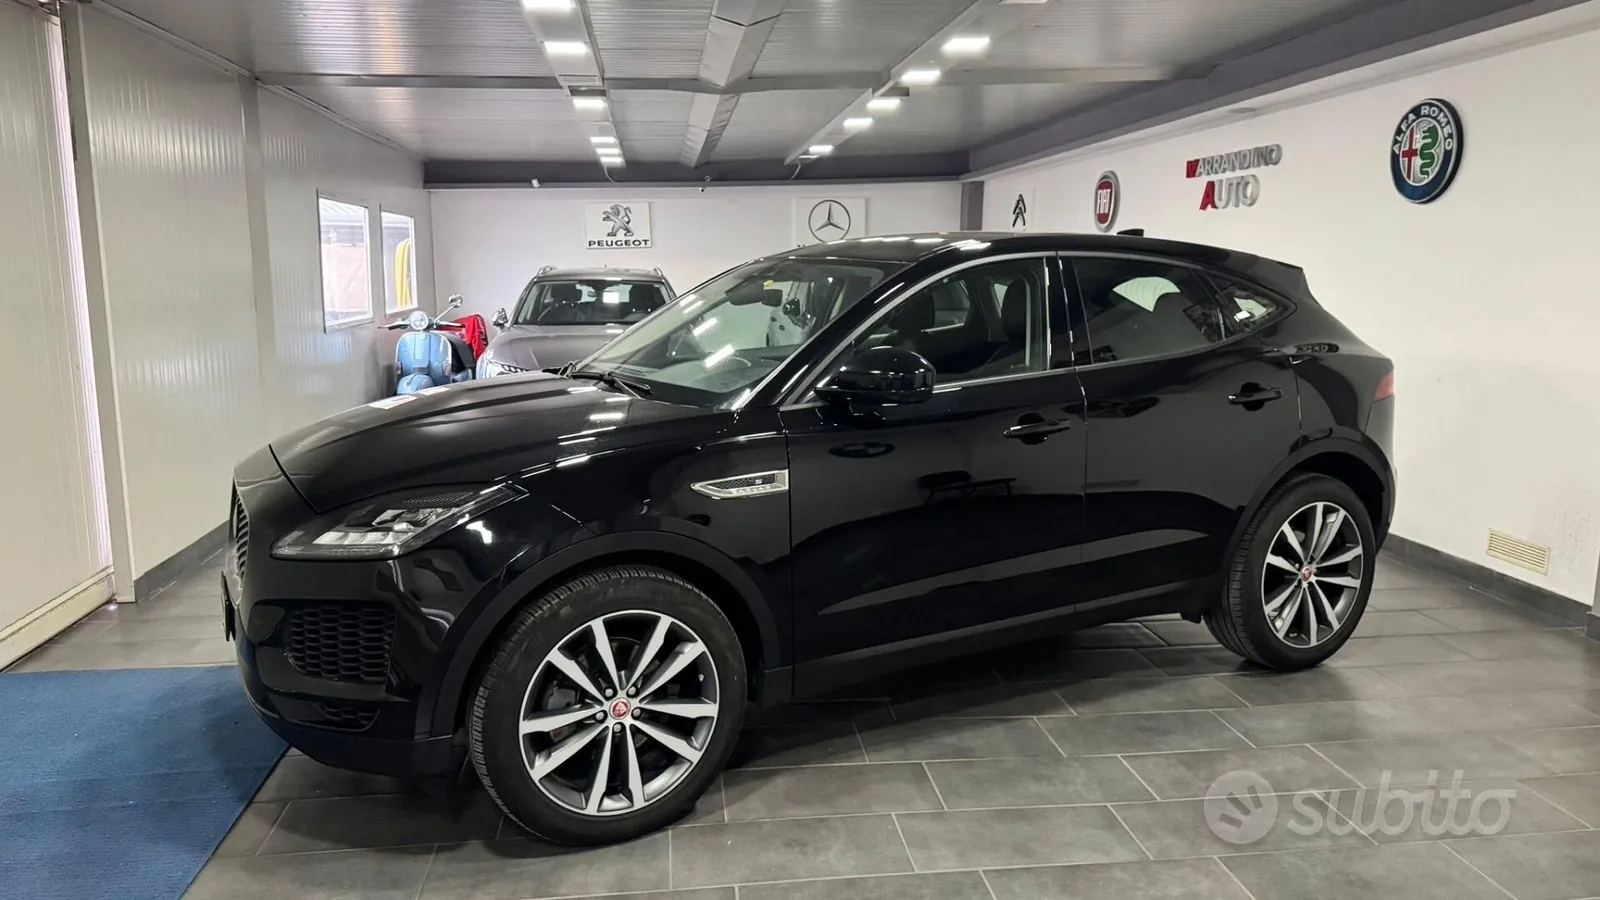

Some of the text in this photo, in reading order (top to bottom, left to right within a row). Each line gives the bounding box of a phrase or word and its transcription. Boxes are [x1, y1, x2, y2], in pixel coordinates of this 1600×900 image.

[1393, 105, 1453, 154] ALFA ROMEO
[1096, 188, 1111, 214] FIAT
[1199, 174, 1260, 211] AUTO
[588, 239, 650, 247] PEUGEOT
